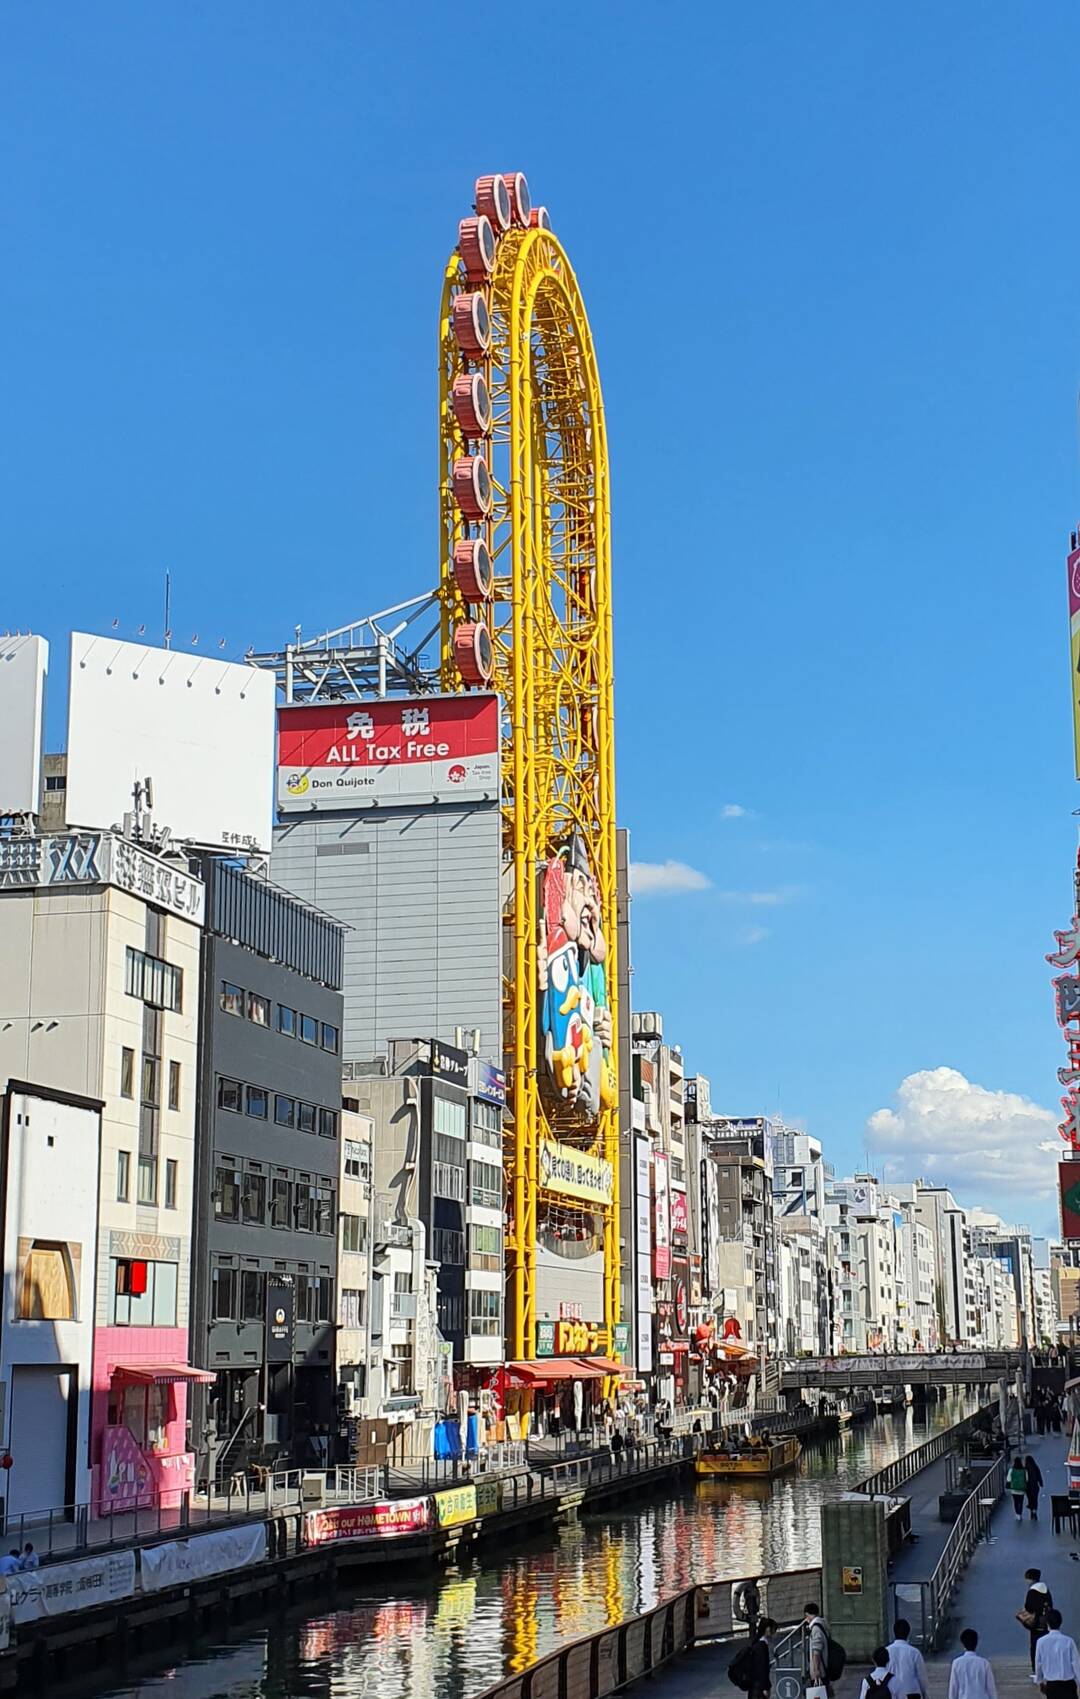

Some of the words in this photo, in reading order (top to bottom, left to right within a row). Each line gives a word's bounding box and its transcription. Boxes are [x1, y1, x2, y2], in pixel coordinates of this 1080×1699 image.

[326, 745, 360, 763] ALL
[366, 744, 401, 761] Tax
[407, 741, 450, 758] Free
[312, 780, 333, 789] Don
[336, 777, 375, 789] Quijote
[357, 1511, 411, 1527] HOMETOWN
